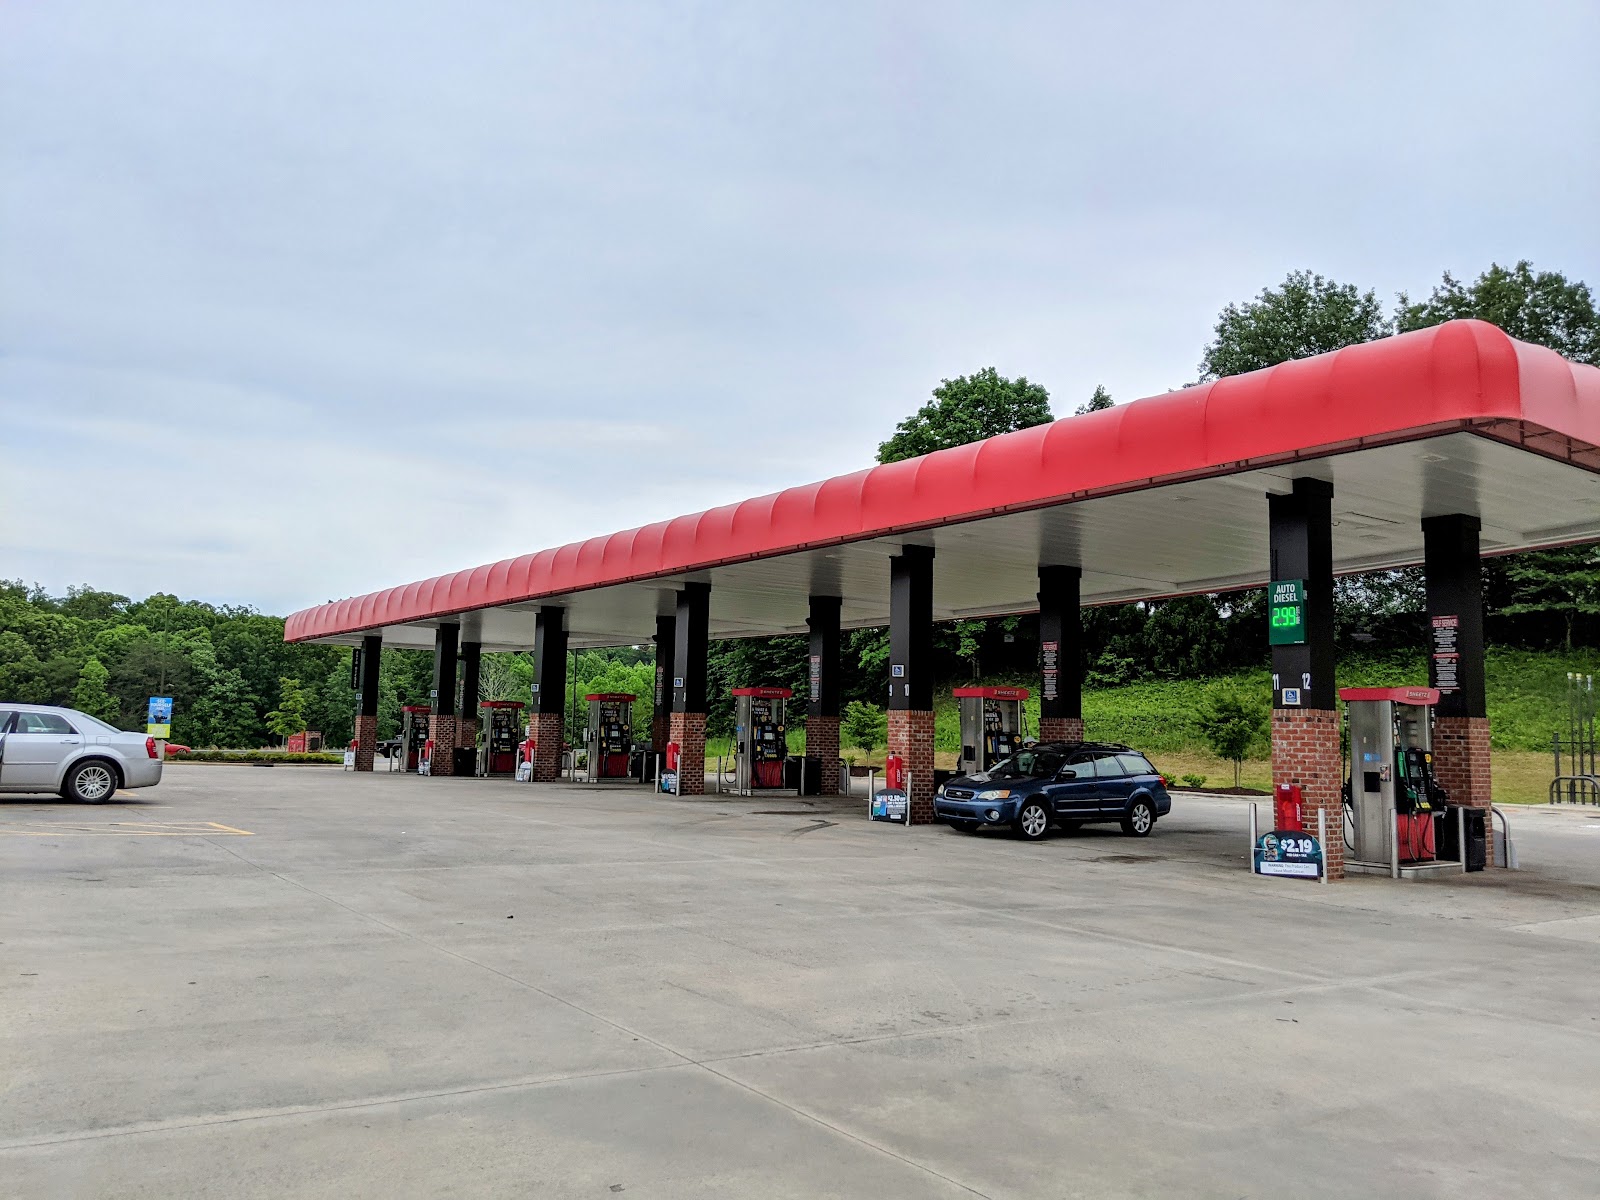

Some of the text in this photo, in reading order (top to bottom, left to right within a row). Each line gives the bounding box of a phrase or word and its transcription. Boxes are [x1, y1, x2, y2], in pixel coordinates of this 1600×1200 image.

[1275, 584, 1296, 594] AUTO
[1273, 593, 1298, 603] DIESEL
[1272, 606, 1296, 627] 2.99
[1272, 673, 1280, 690] 11
[1302, 672, 1311, 690] 12
[1280, 839, 1312, 853] $2.19
